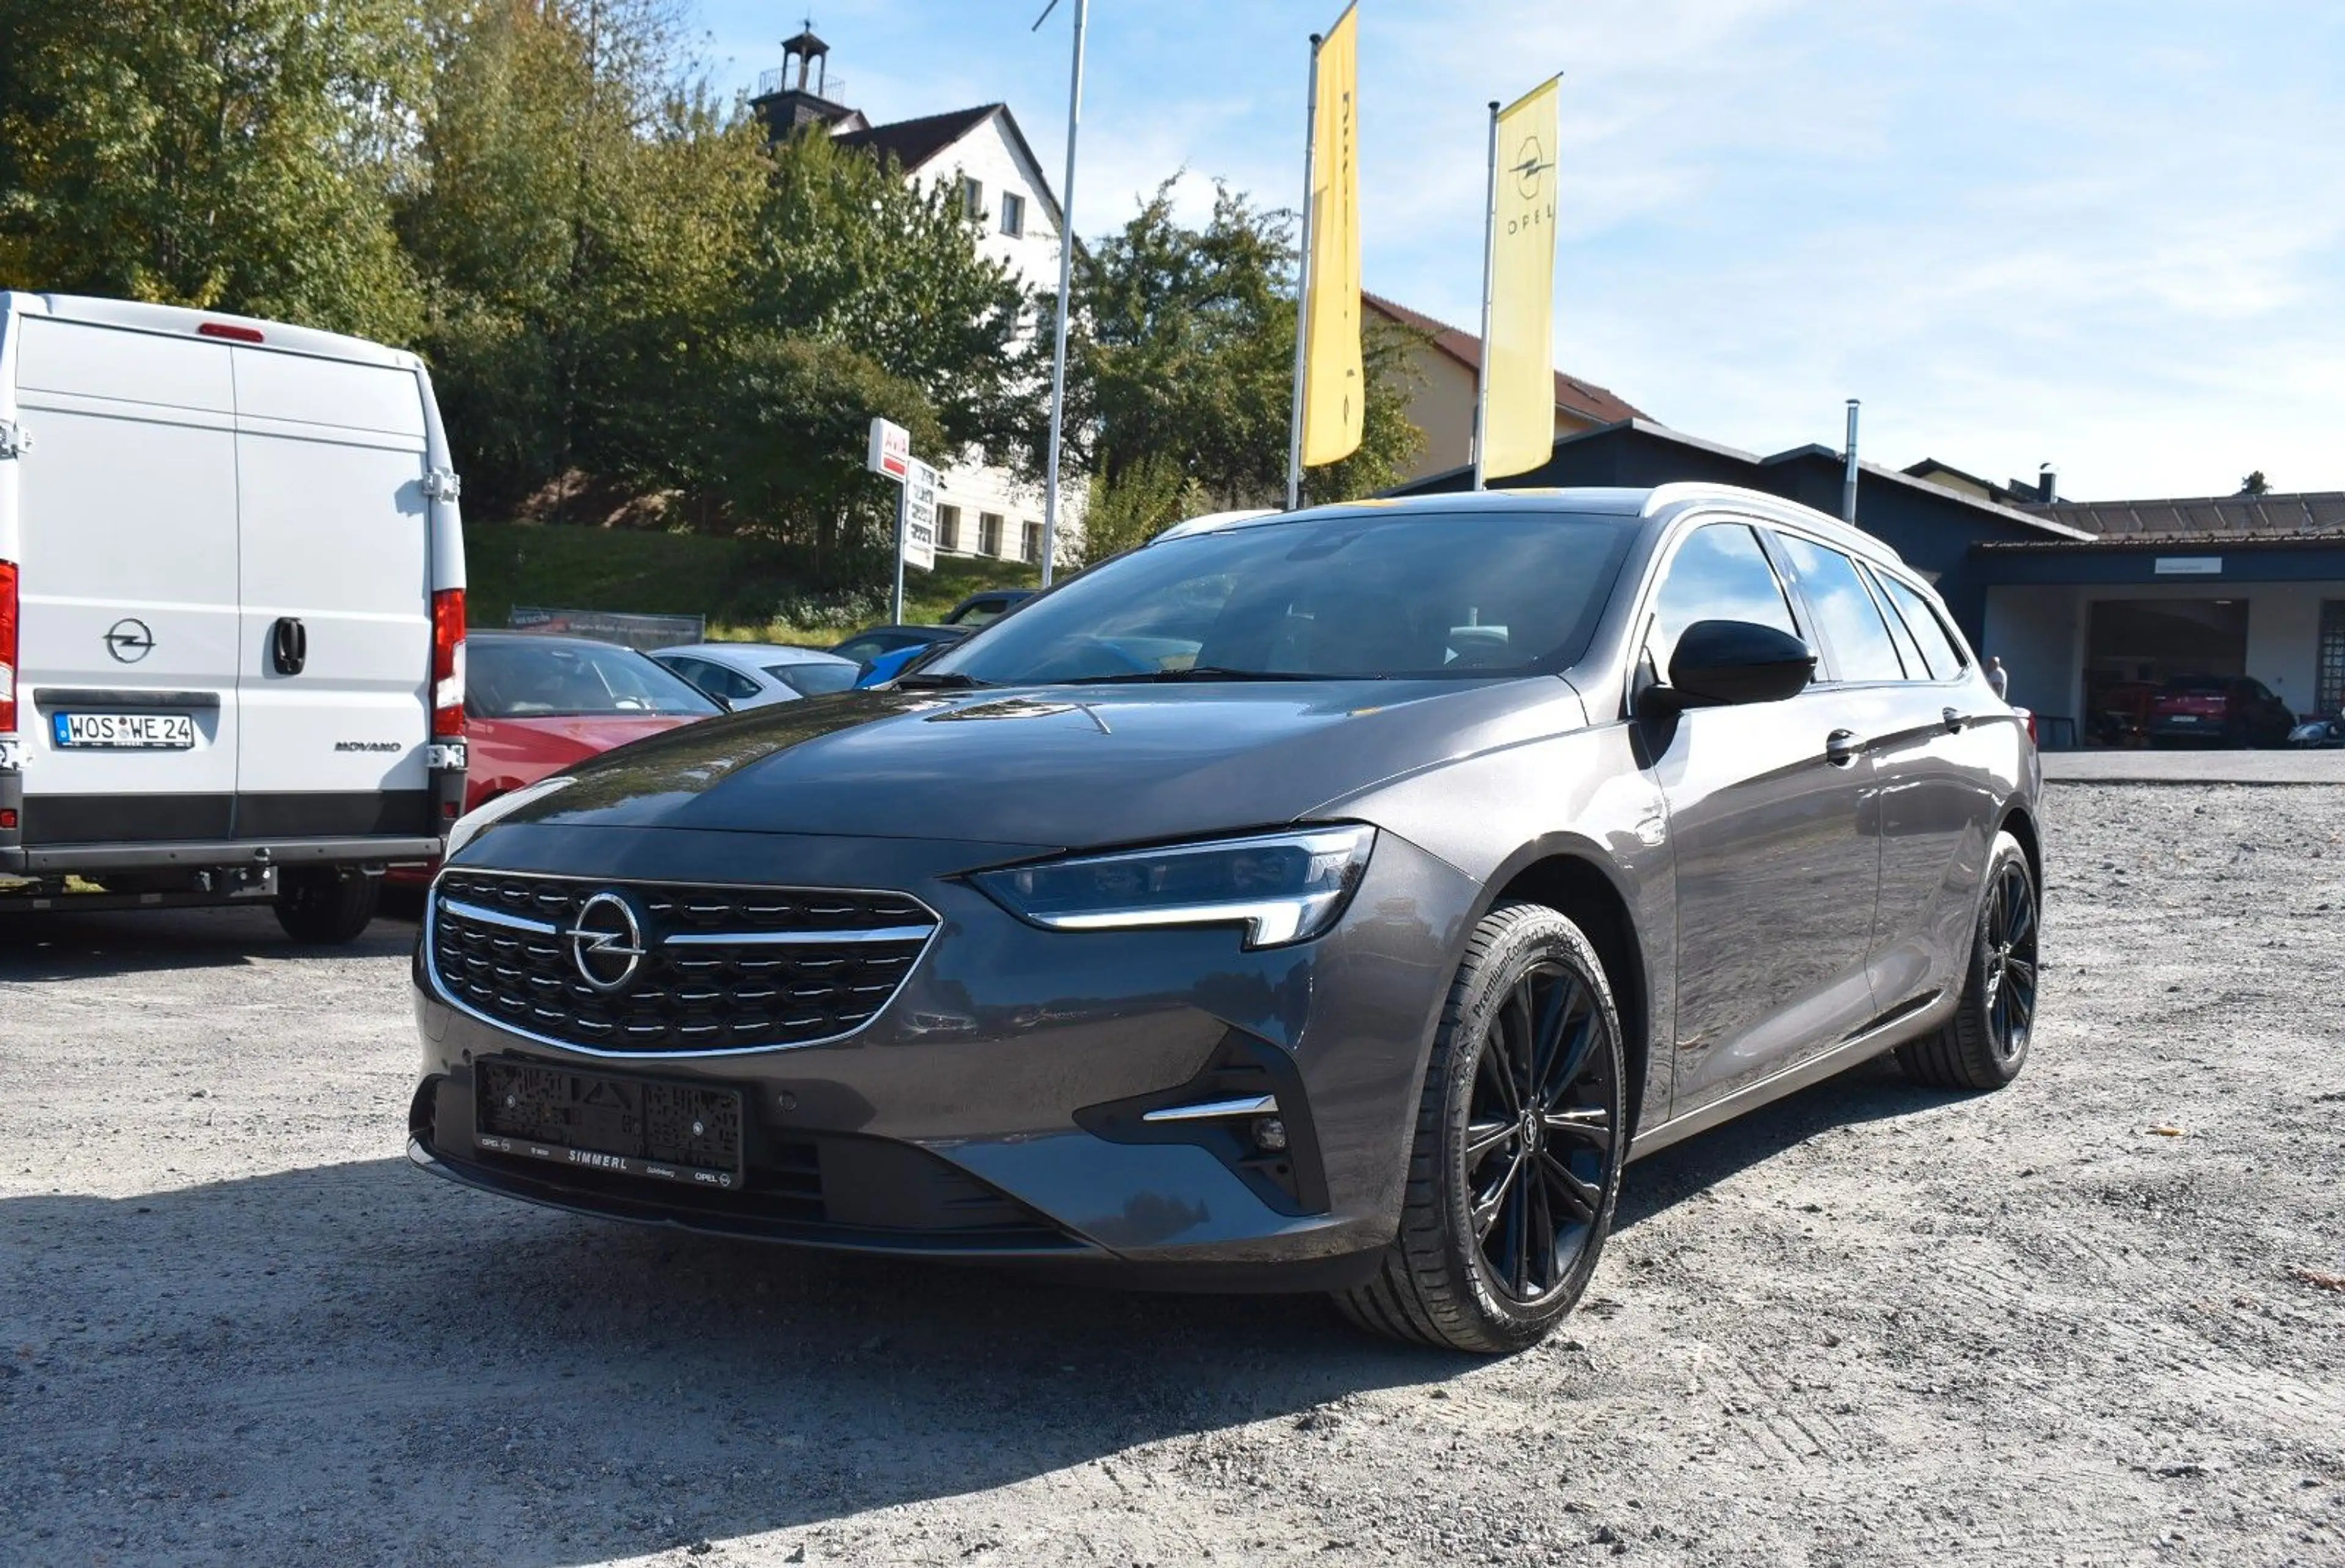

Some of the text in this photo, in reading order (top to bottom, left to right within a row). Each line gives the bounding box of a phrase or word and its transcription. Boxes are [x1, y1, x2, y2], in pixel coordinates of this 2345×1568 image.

[1507, 203, 1553, 236] OPEL
[70, 717, 115, 739] WOS
[129, 718, 159, 739] WE
[164, 719, 191, 739] 24
[568, 1150, 627, 1170] SIMMERL
[694, 1172, 718, 1183] OPEL
